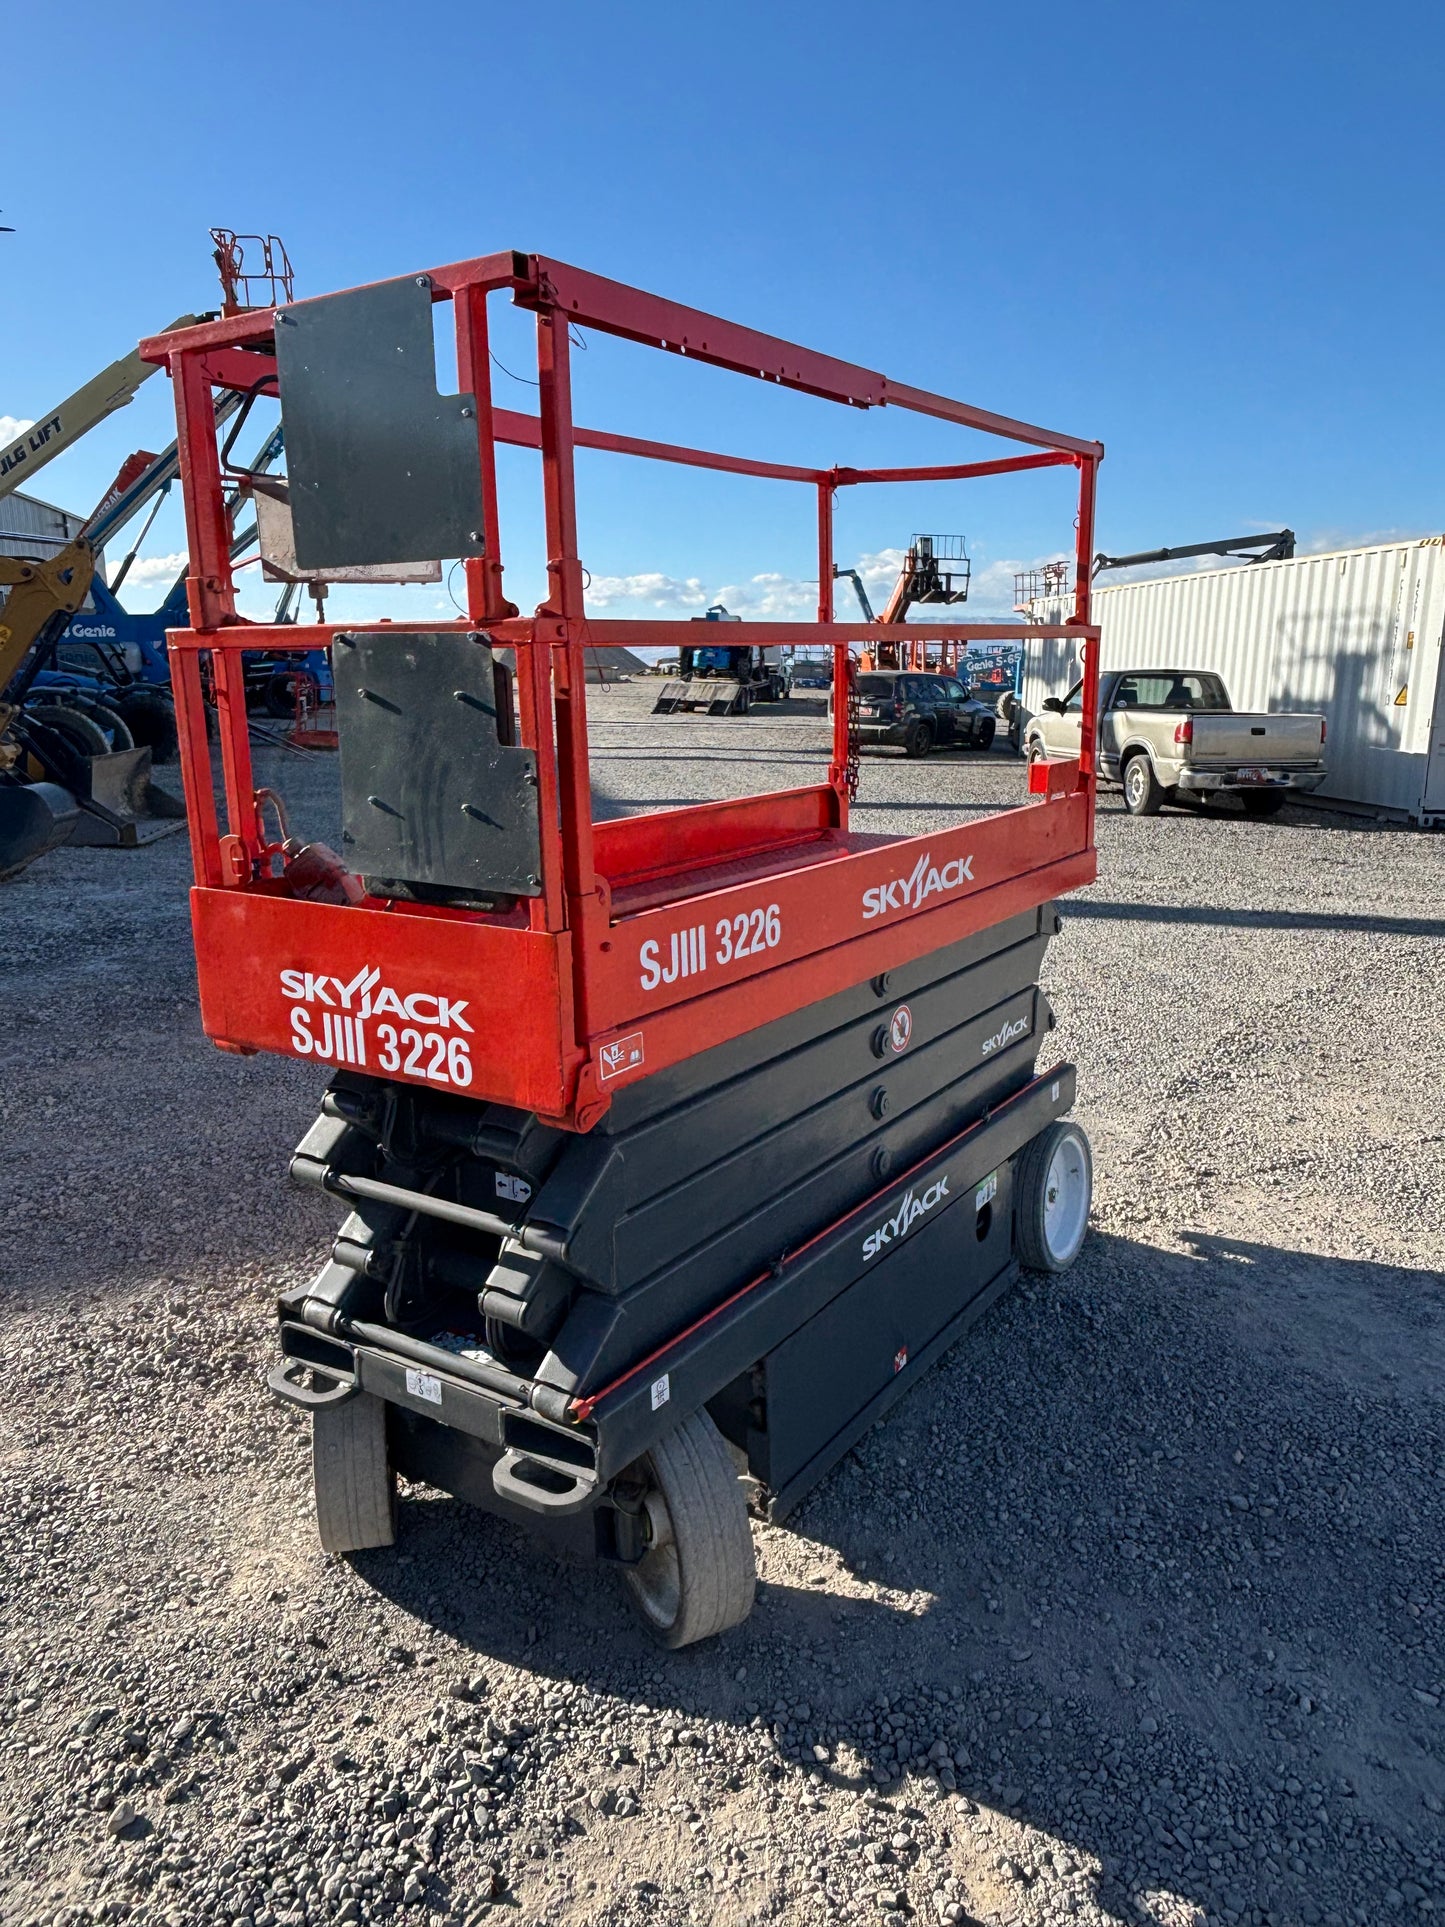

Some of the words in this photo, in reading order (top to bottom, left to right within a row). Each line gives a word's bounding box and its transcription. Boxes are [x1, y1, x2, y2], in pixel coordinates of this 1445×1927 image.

[0, 445, 27, 476] JLG
[29, 416, 61, 451] LIFT
[72, 624, 116, 638] Genie
[967, 659, 994, 671] Genie
[862, 852, 975, 919] SKYJACK
[640, 925, 706, 991] SJIII
[716, 904, 781, 965] 3226
[280, 964, 474, 1032] SKYJACK
[290, 1006, 366, 1065] SJIII
[376, 1023, 473, 1087] 3226
[982, 1016, 1028, 1055] SKYJACK
[862, 1175, 950, 1261] SKYJACK
